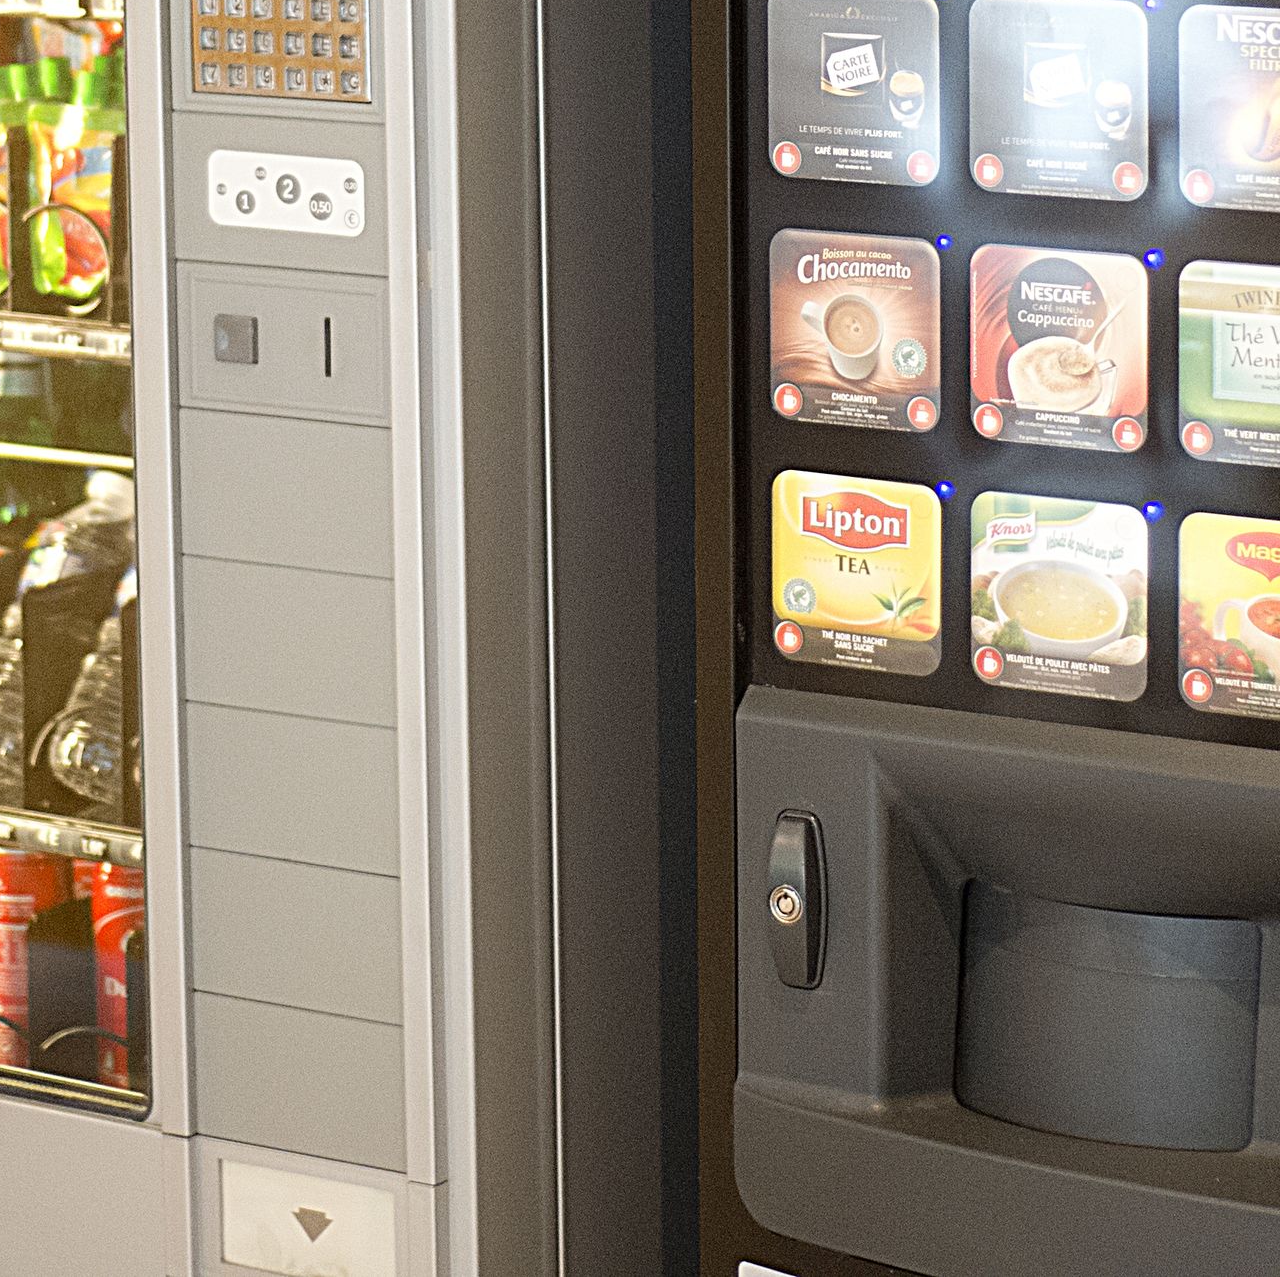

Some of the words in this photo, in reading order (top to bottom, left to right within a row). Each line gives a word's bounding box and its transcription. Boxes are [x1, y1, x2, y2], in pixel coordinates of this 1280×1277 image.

[833, 53, 870, 71] CARTE
[836, 66, 873, 84] NOIRE
[799, 125, 807, 133] LE
[809, 125, 832, 135] TEMPS
[834, 127, 843, 135] DE
[845, 128, 863, 136] VIVRE
[865, 129, 883, 137] PLUS
[815, 146, 831, 155] CAFÉ
[851, 149, 868, 158] SANS
[870, 150, 893, 159] SUCRE
[282, 179, 293, 199] 2
[242, 194, 249, 210] 1
[311, 202, 331, 214] 0,50
[823, 248, 854, 259] Boisson
[869, 251, 892, 259] cacao
[797, 254, 912, 284] Chocamento
[1021, 281, 1093, 305] NESCAFÉ
[1032, 303, 1053, 312] CAFÉ
[1017, 310, 1095, 329] Cappuccino
[1225, 322, 1264, 344] Thé
[832, 393, 878, 404] CHOCAMENTO
[1035, 412, 1080, 424] CAPPUCCINO
[1224, 428, 1237, 437] THÉ
[1240, 429, 1258, 440] VERT
[810, 500, 900, 537] Lipton
[989, 522, 1033, 538] Knorr
[835, 553, 870, 575] TEA
[822, 629, 834, 639] THÉ
[836, 632, 850, 641] NOIR
[852, 634, 861, 643] EN
[863, 635, 887, 647] SACHET
[834, 640, 851, 650] SANS
[853, 642, 874, 653] SUCRE
[1006, 652, 1034, 664] VELOUTÉ
[1035, 657, 1043, 665] DE
[1045, 658, 1069, 669] POULET
[1071, 660, 1088, 671] AVEC
[1089, 662, 1110, 674] PÂTES
